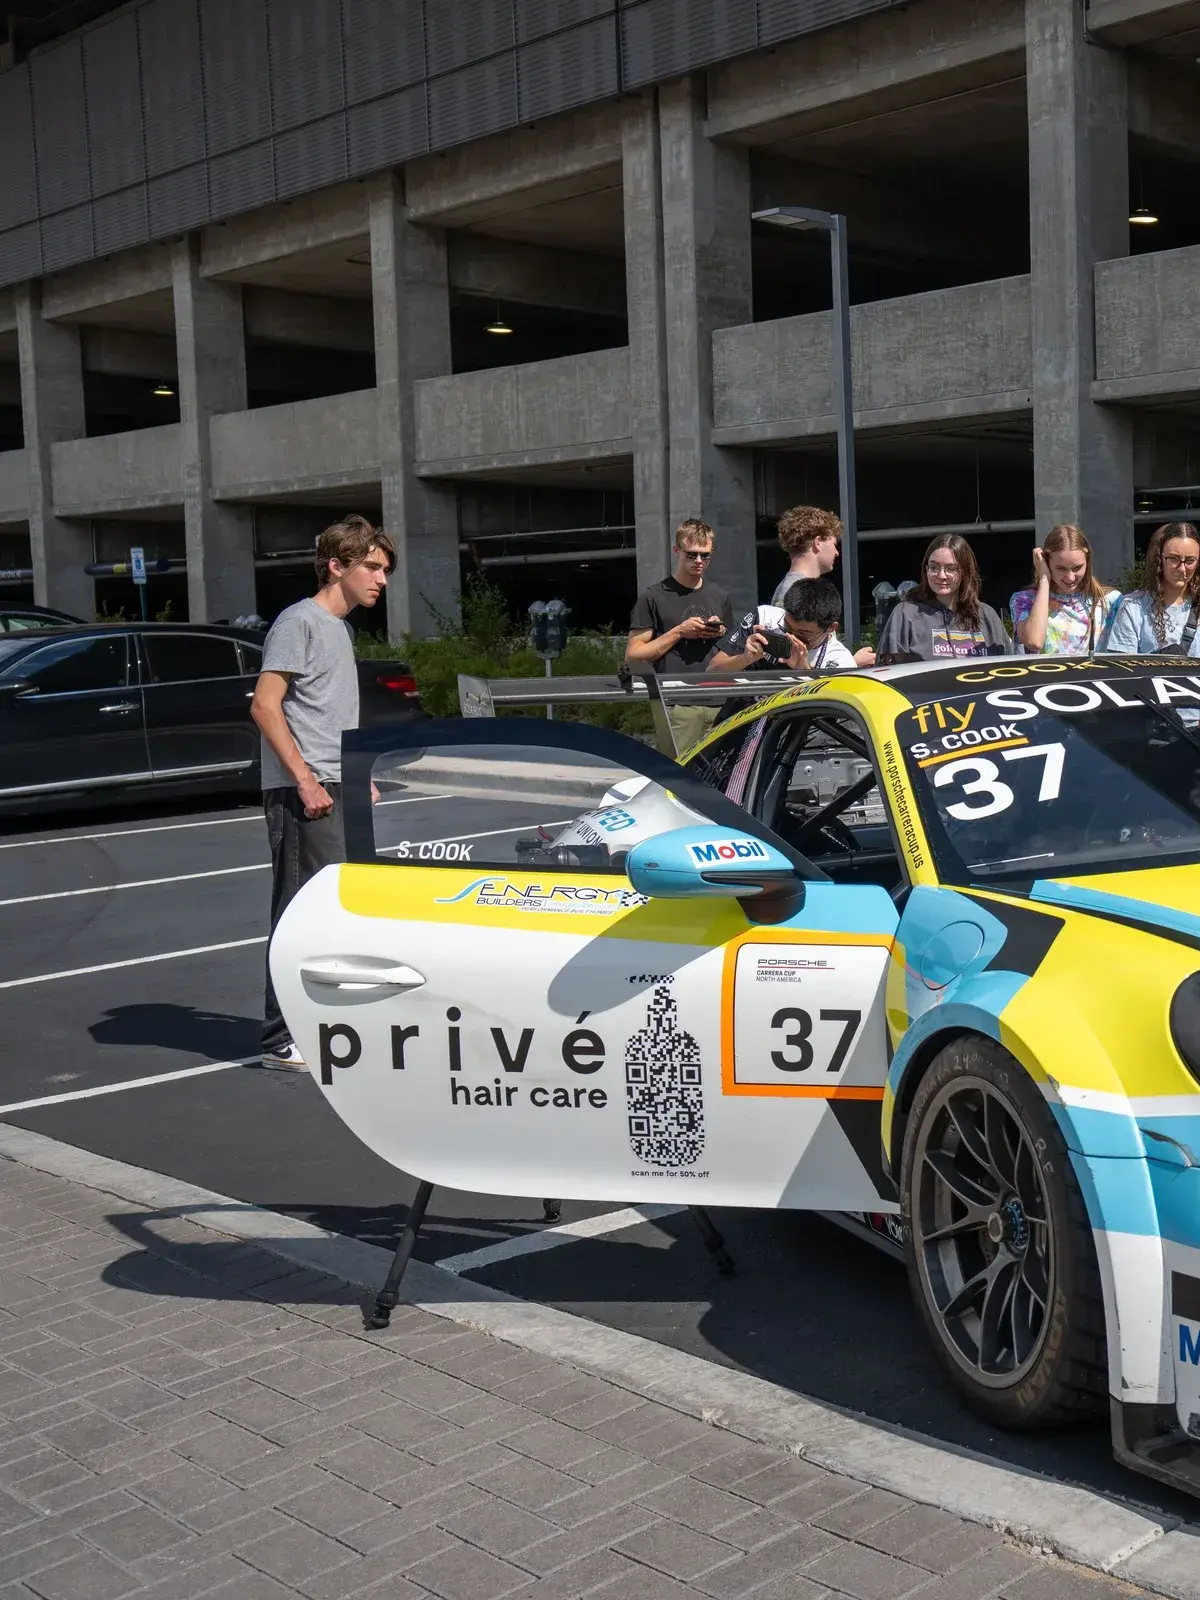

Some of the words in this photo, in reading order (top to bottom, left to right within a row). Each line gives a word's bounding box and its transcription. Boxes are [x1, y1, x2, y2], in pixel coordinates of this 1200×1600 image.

[955, 660, 1110, 683] COOK
[911, 702, 977, 735] fly
[910, 742, 939, 759] S.
[941, 722, 1025, 750] COOK
[933, 742, 1067, 821] 37
[882, 740, 925, 869] www.porschecarreracup.us
[397, 840, 414, 859] S.
[418, 841, 475, 861] COOK
[691, 841, 765, 863] Mobil
[476, 898, 542, 908] BUILDERS
[757, 958, 828, 967] PORSCHE
[776, 976, 802, 984] AMERICA
[318, 1006, 606, 1086] privé
[770, 1007, 862, 1073] 37
[450, 1077, 519, 1107] hair
[529, 1085, 608, 1109] care
[630, 1169, 650, 1177] scan
[665, 1169, 678, 1178] for
[679, 1170, 696, 1178] 50%
[697, 1170, 710, 1178] off
